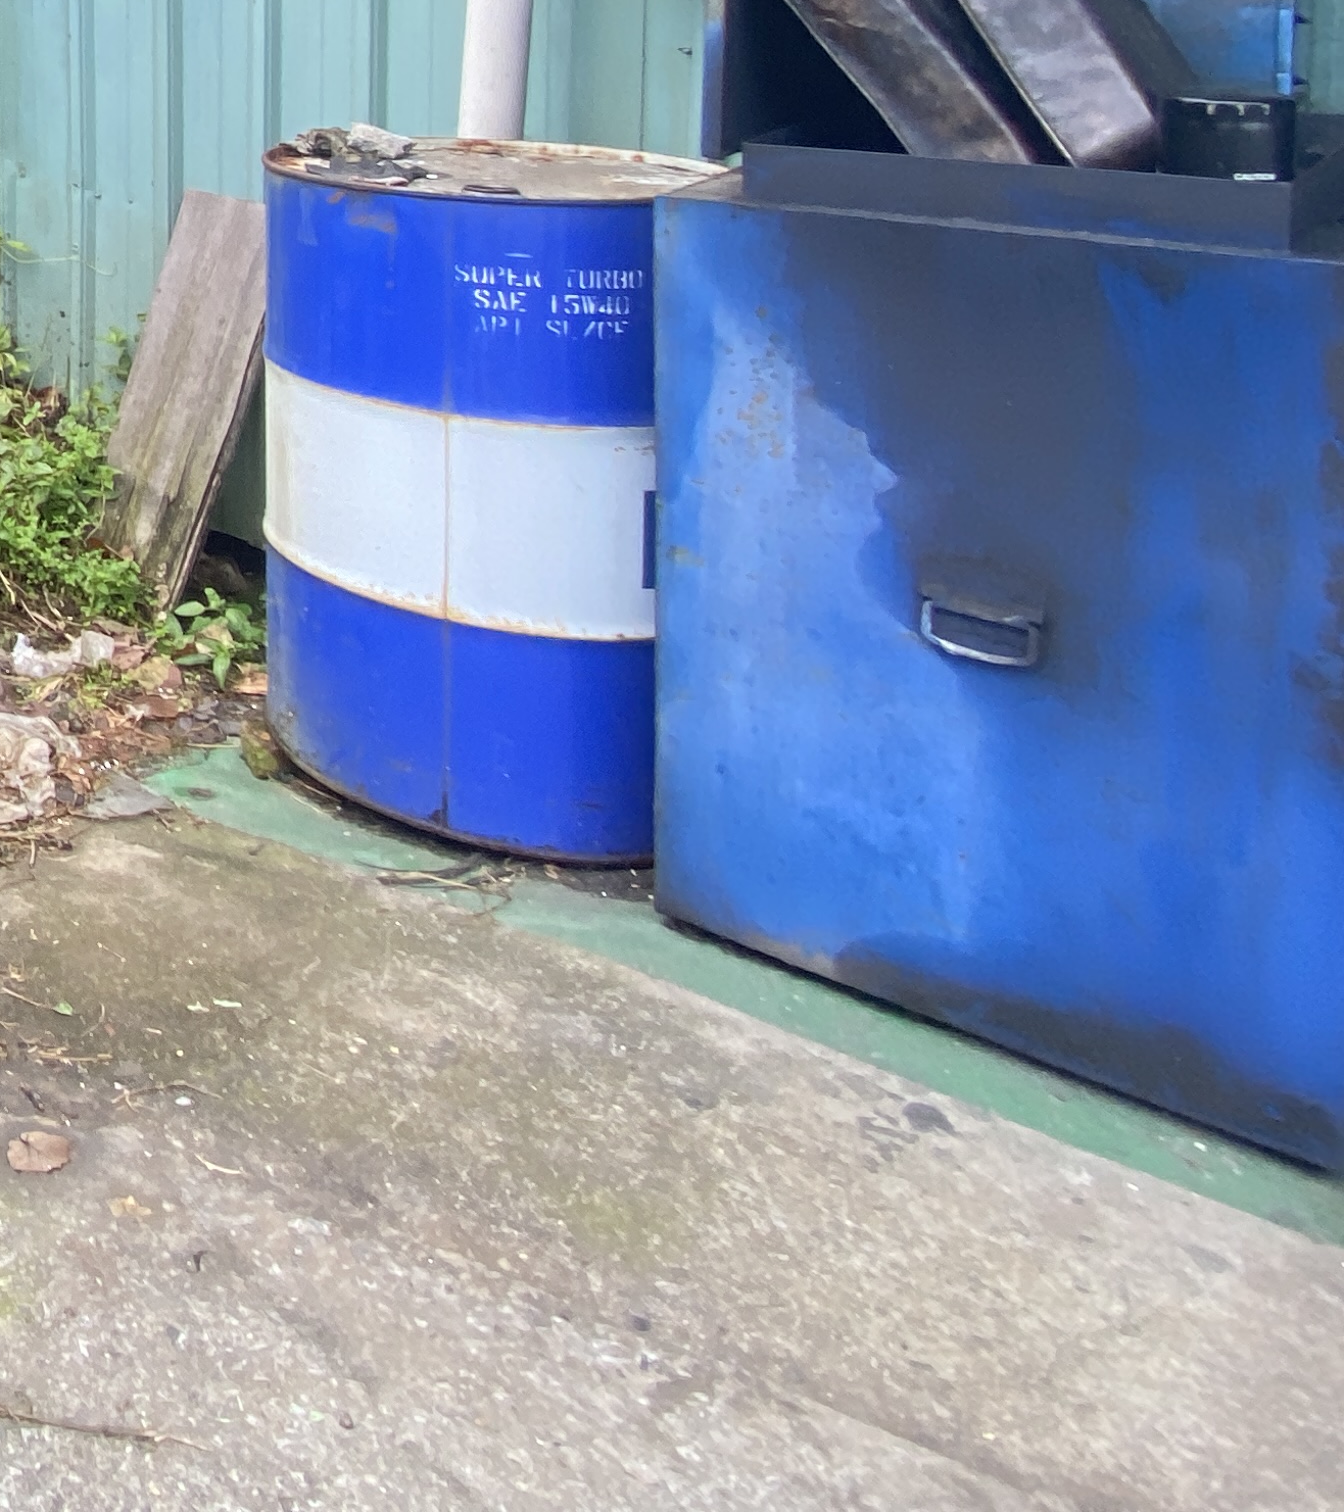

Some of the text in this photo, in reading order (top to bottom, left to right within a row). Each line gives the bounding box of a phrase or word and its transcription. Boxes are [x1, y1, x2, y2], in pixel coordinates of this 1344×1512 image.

[454, 264, 643, 289] SUPER TURBO
[473, 289, 630, 315] SAE 15W40
[475, 315, 520, 336] API
